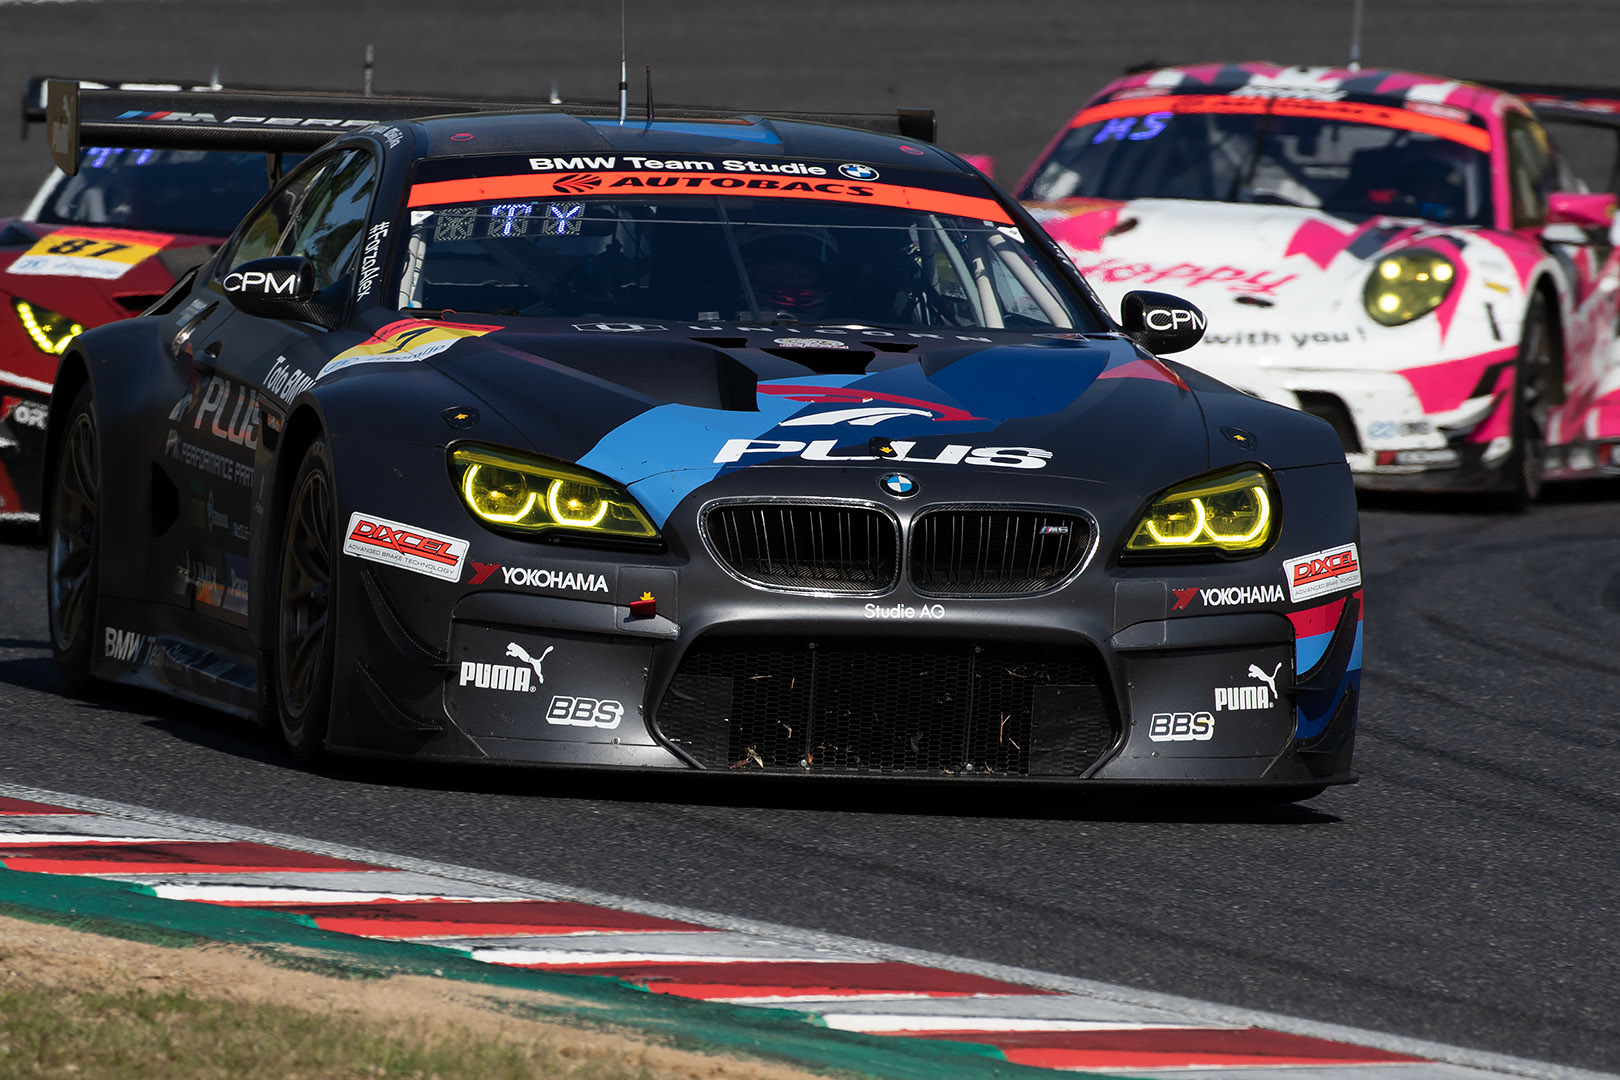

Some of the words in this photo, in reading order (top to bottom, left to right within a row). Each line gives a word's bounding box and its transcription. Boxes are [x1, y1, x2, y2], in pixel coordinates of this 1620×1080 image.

[529, 156, 616, 171] BMW
[622, 156, 717, 172] Team
[721, 159, 828, 177] Studie
[610, 176, 878, 197] AUTOBACS
[357, 221, 391, 303] #ForzaAlex
[223, 271, 297, 296] CPM
[378, 326, 438, 355] 7
[262, 355, 291, 395] Toto
[279, 368, 318, 406] BMW
[712, 438, 1053, 469] PLUS
[348, 519, 461, 567] DIXCEL
[347, 543, 381, 557] ADVANCED
[381, 550, 403, 562] BRAKE
[404, 556, 456, 575] TECHNOLOGY
[1292, 550, 1359, 588] DIXCEL
[501, 566, 609, 593] YOKOHAMA
[1199, 585, 1285, 606] YOKOHAMA
[864, 603, 915, 619] Studie
[919, 603, 946, 619] AG
[104, 626, 147, 664] BMW
[458, 660, 532, 692] PUMA
[545, 695, 625, 730] BBS
[1213, 686, 1269, 711] PUMA
[1148, 712, 1216, 742] BBS
